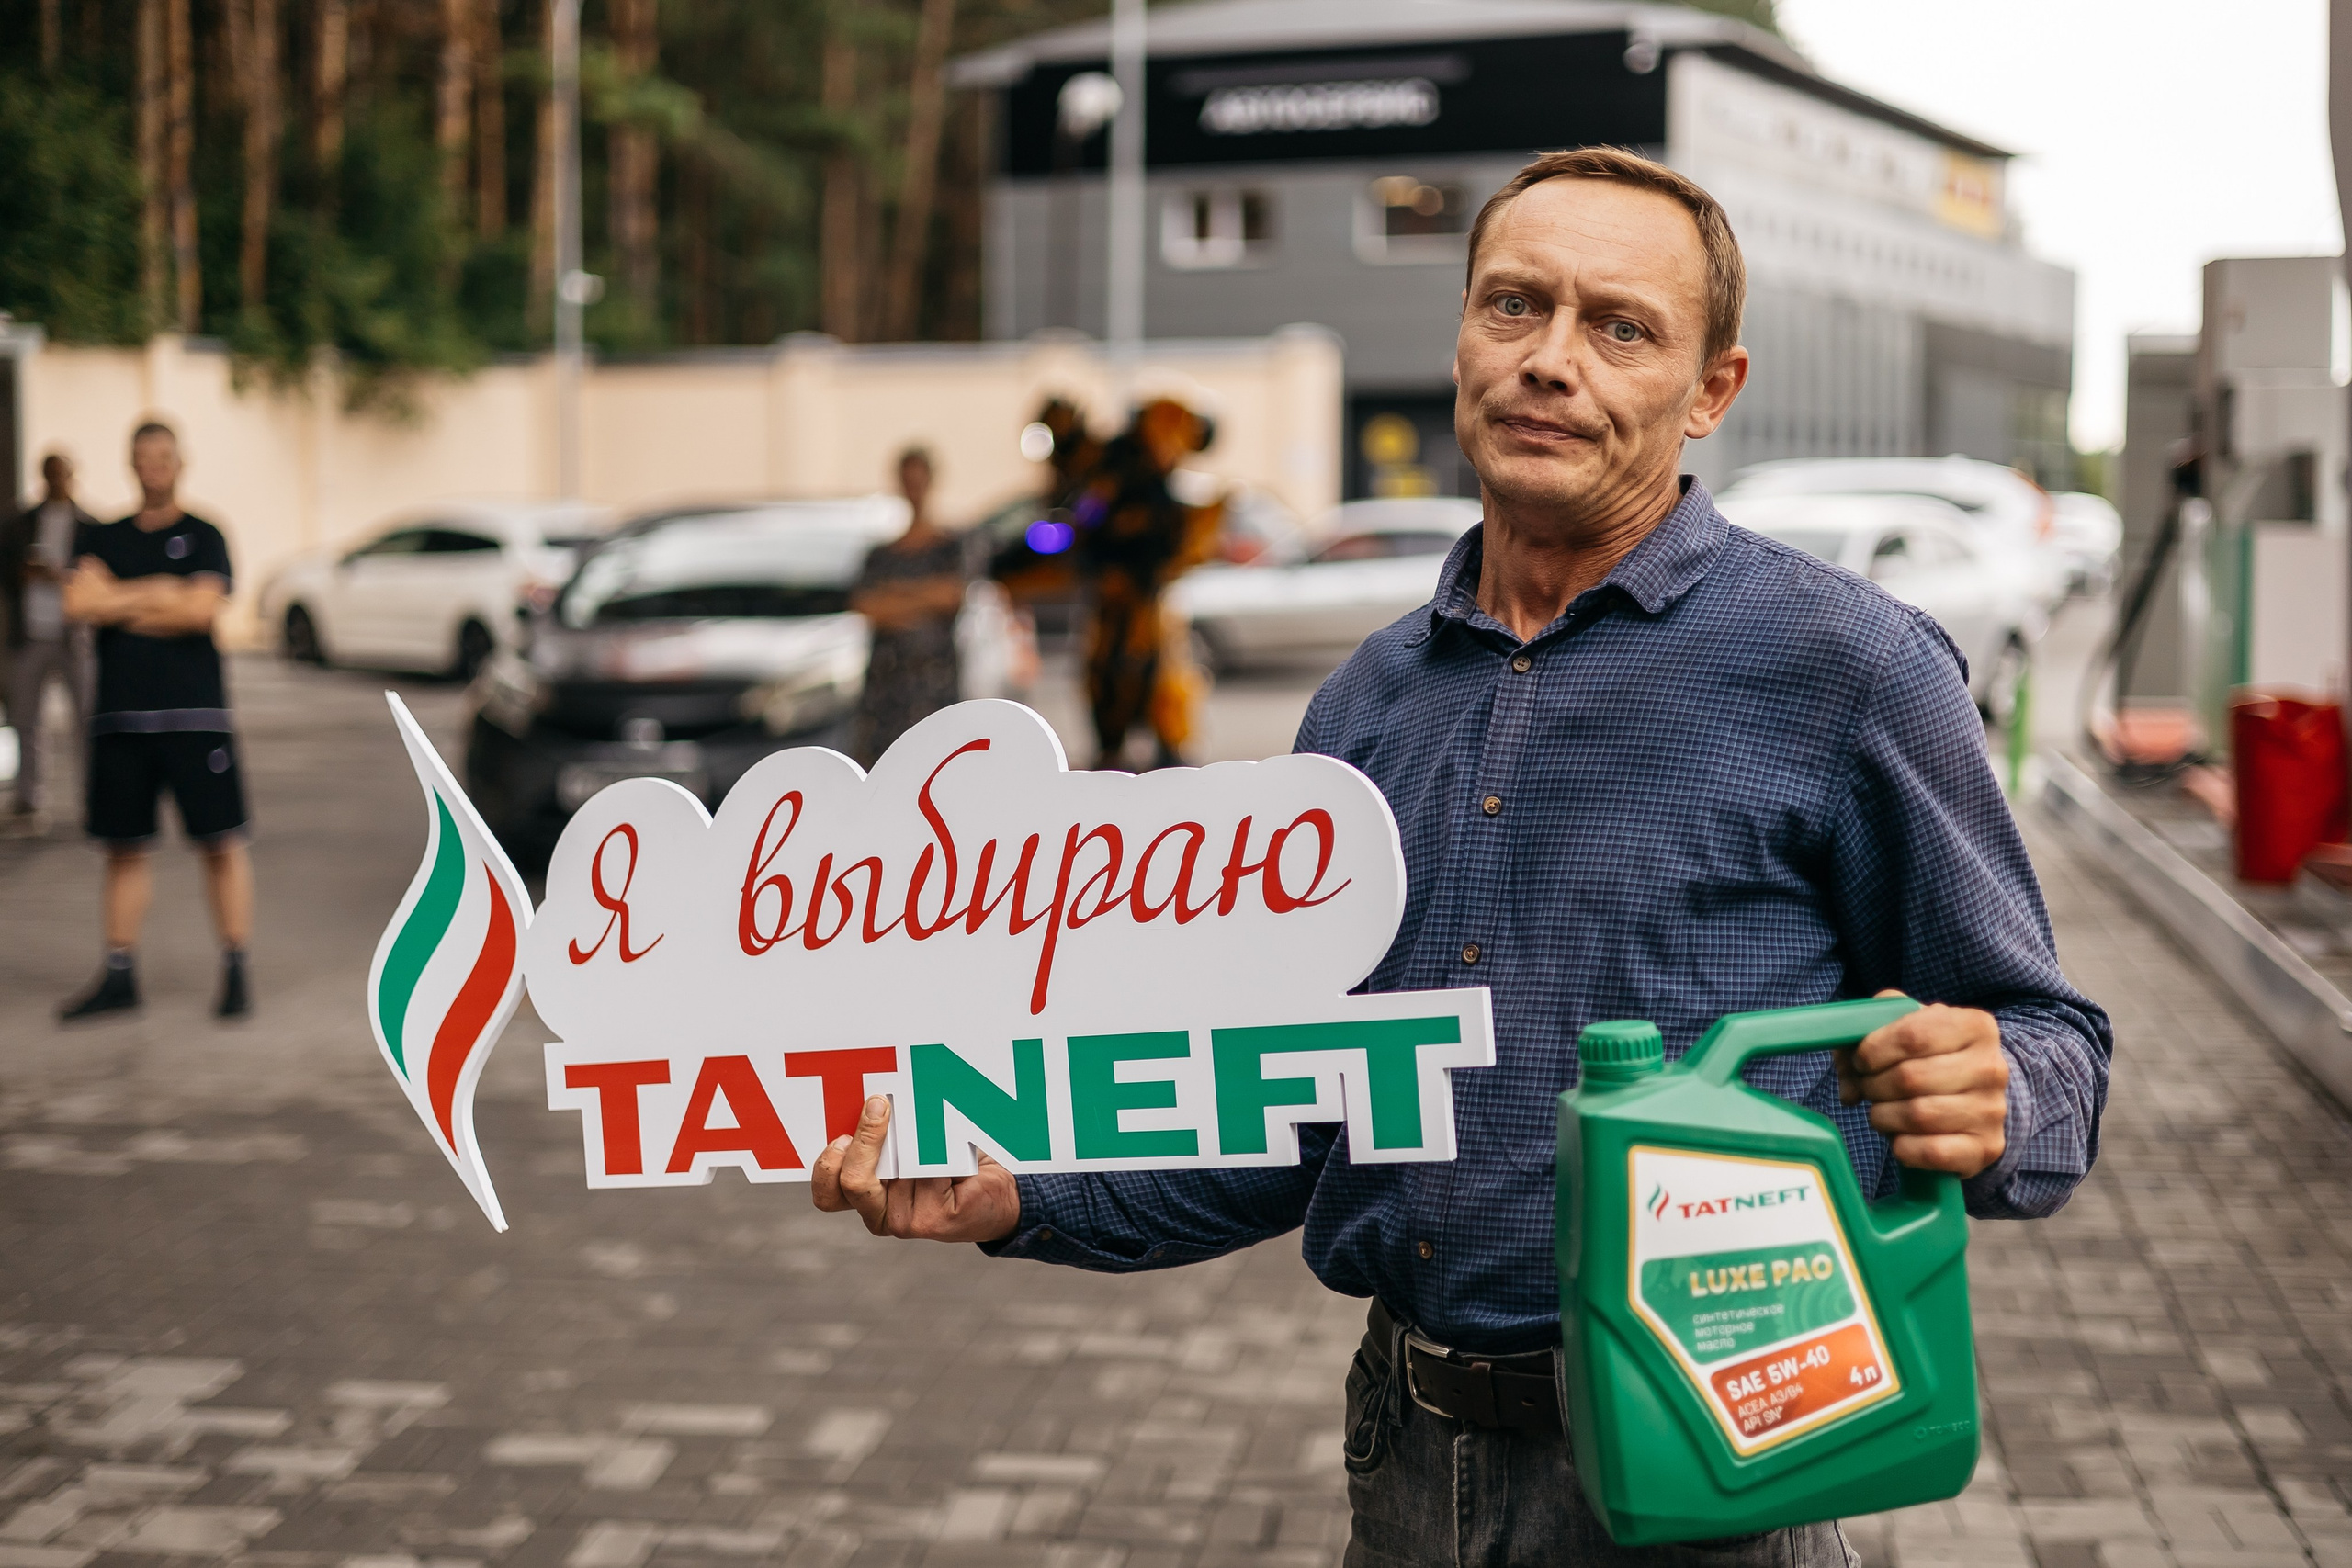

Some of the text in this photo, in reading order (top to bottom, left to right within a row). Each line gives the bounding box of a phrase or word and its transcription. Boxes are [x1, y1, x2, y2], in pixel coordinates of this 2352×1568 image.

[568, 737, 1352, 1016] Я выбираю
[563, 1015, 1462, 1176] TATNEFT
[1676, 1185, 1810, 1219] TATNEFT
[1690, 1253, 1834, 1297] LUXE PAO
[1692, 1303, 1785, 1324] синтетическое
[1694, 1320, 1755, 1338] моторное
[1696, 1337, 1736, 1352] масло
[1726, 1344, 1831, 1402] SAE 5W-40
[1737, 1396, 1768, 1418] ACEA
[1743, 1413, 1762, 1432] API
